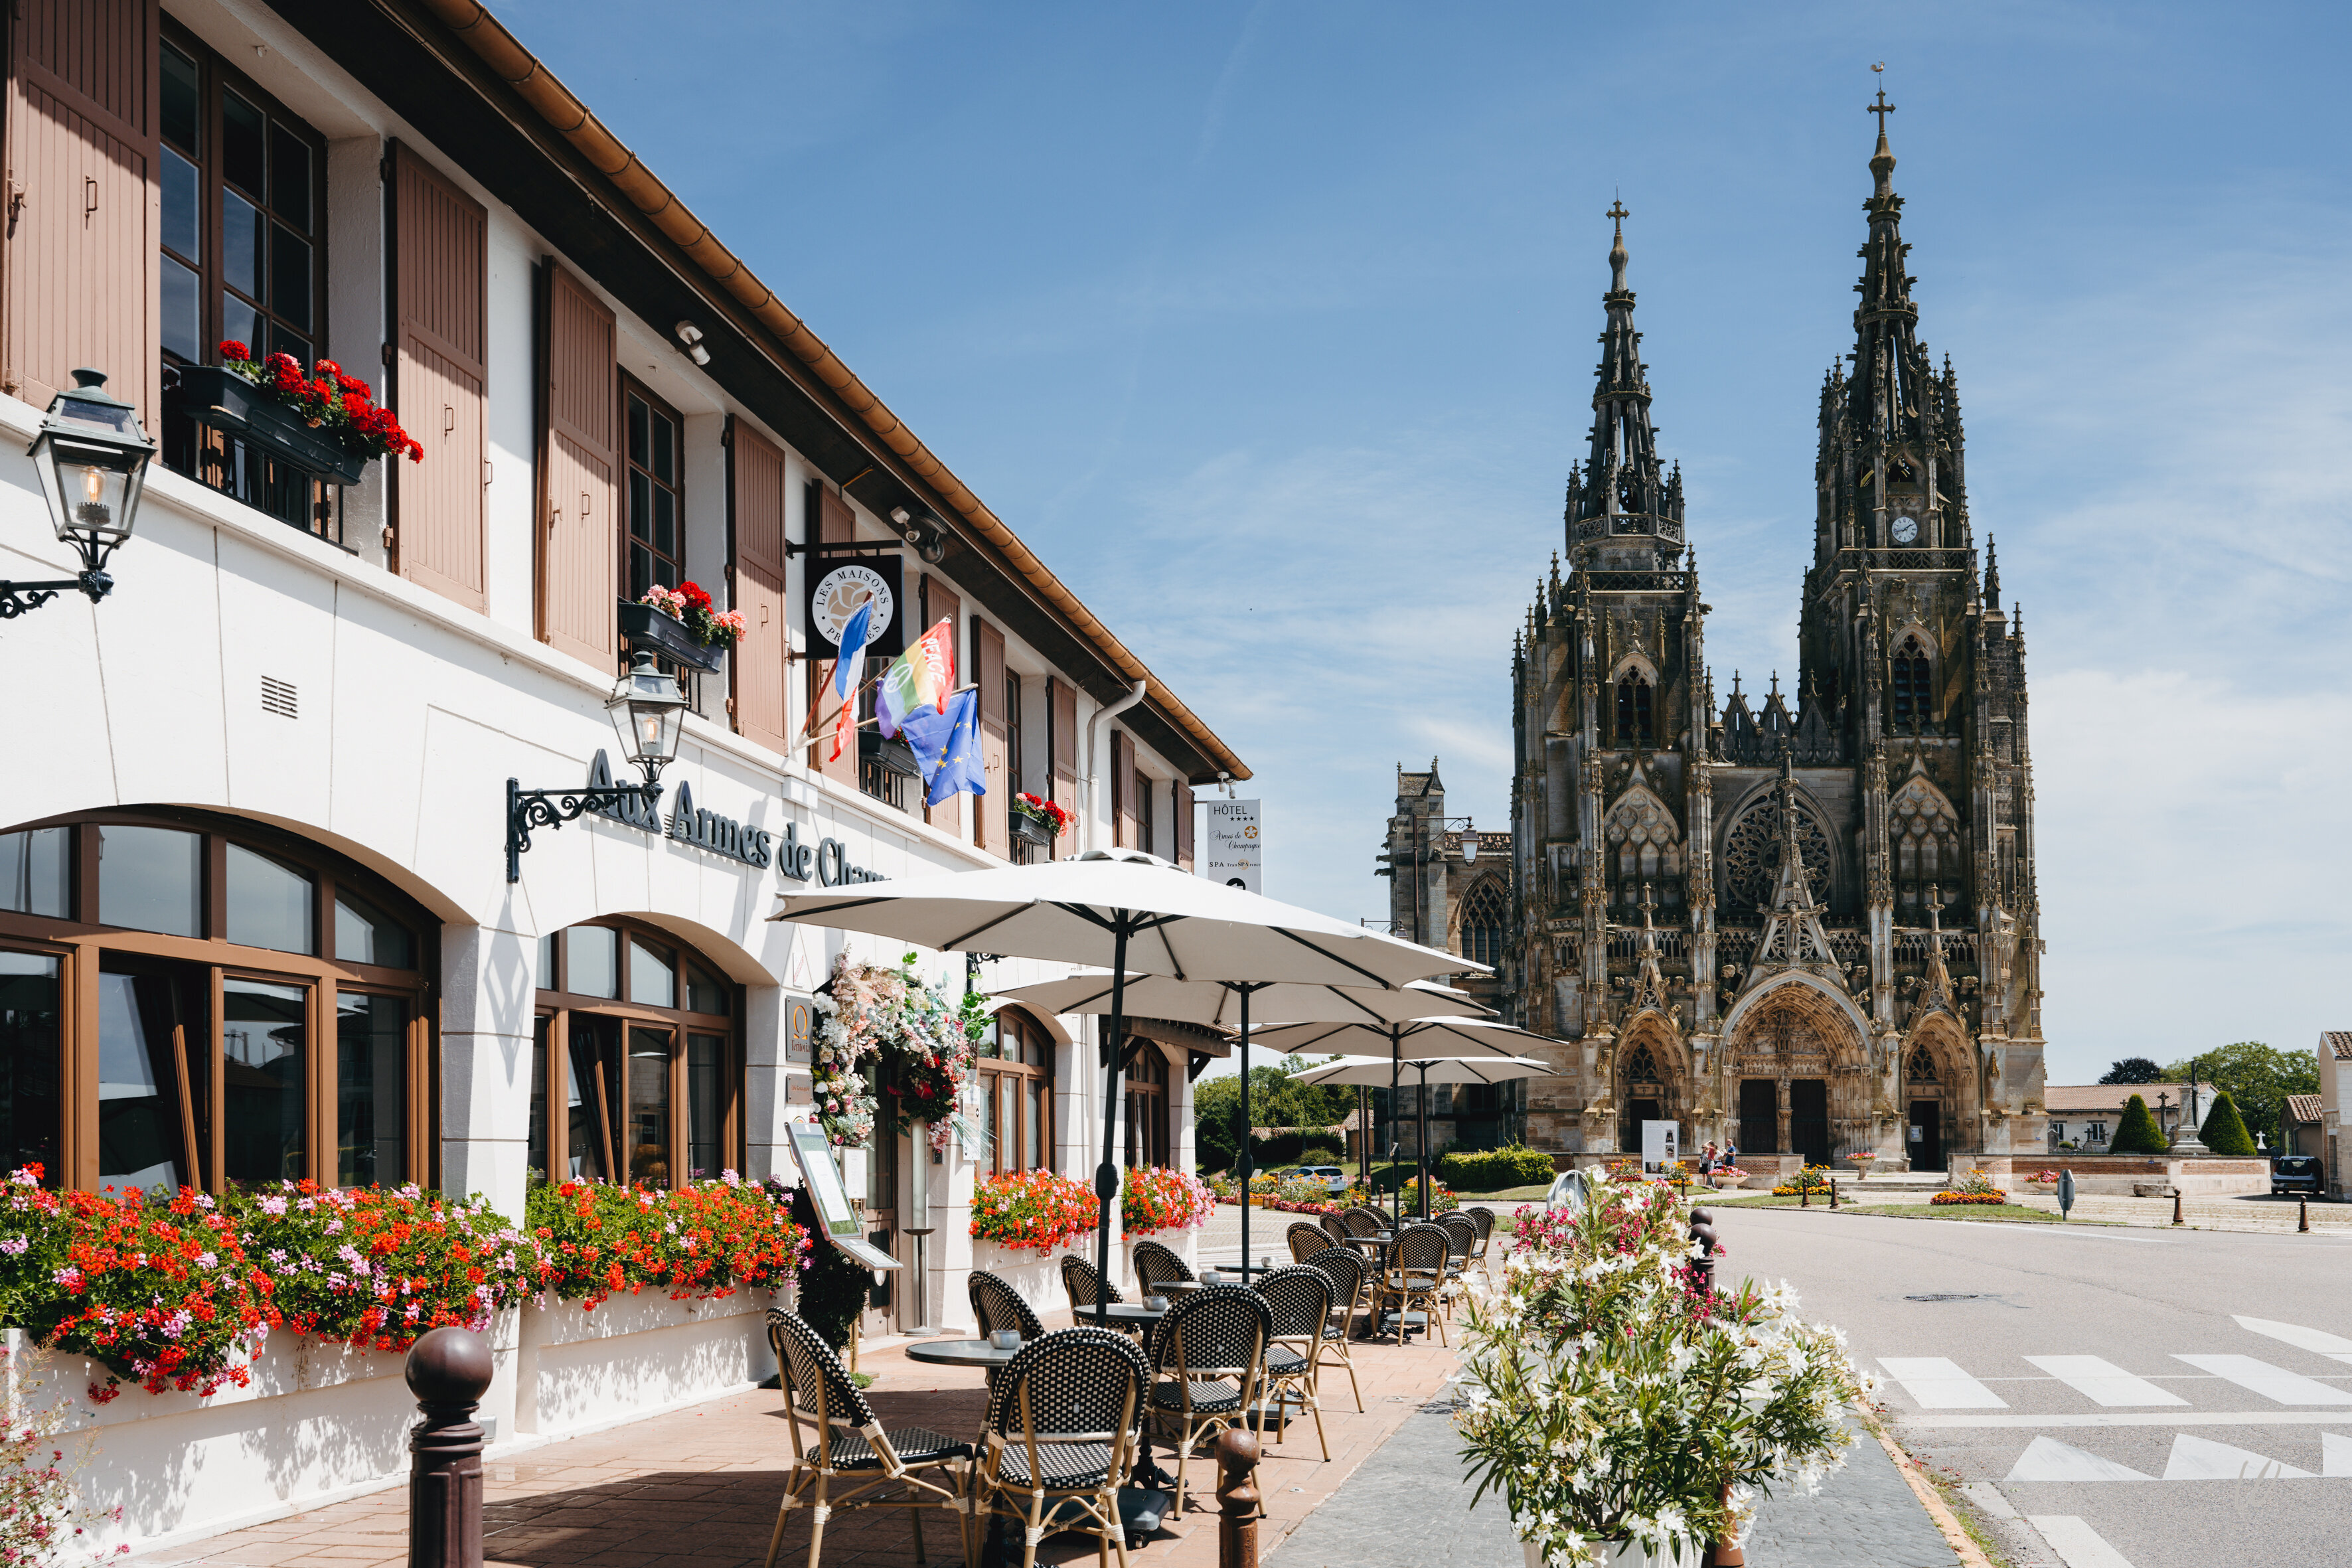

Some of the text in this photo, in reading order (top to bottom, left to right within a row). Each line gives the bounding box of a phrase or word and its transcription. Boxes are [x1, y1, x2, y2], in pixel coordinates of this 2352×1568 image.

[816, 569, 890, 607] LES MAISONS
[826, 623, 881, 643] PRES
[920, 637, 947, 687] PEACE
[586, 748, 663, 834] Aux
[670, 780, 772, 868] Armes
[779, 822, 813, 882] de
[1213, 804, 1247, 815] HÔTEL
[1209, 830, 1234, 842] Armes
